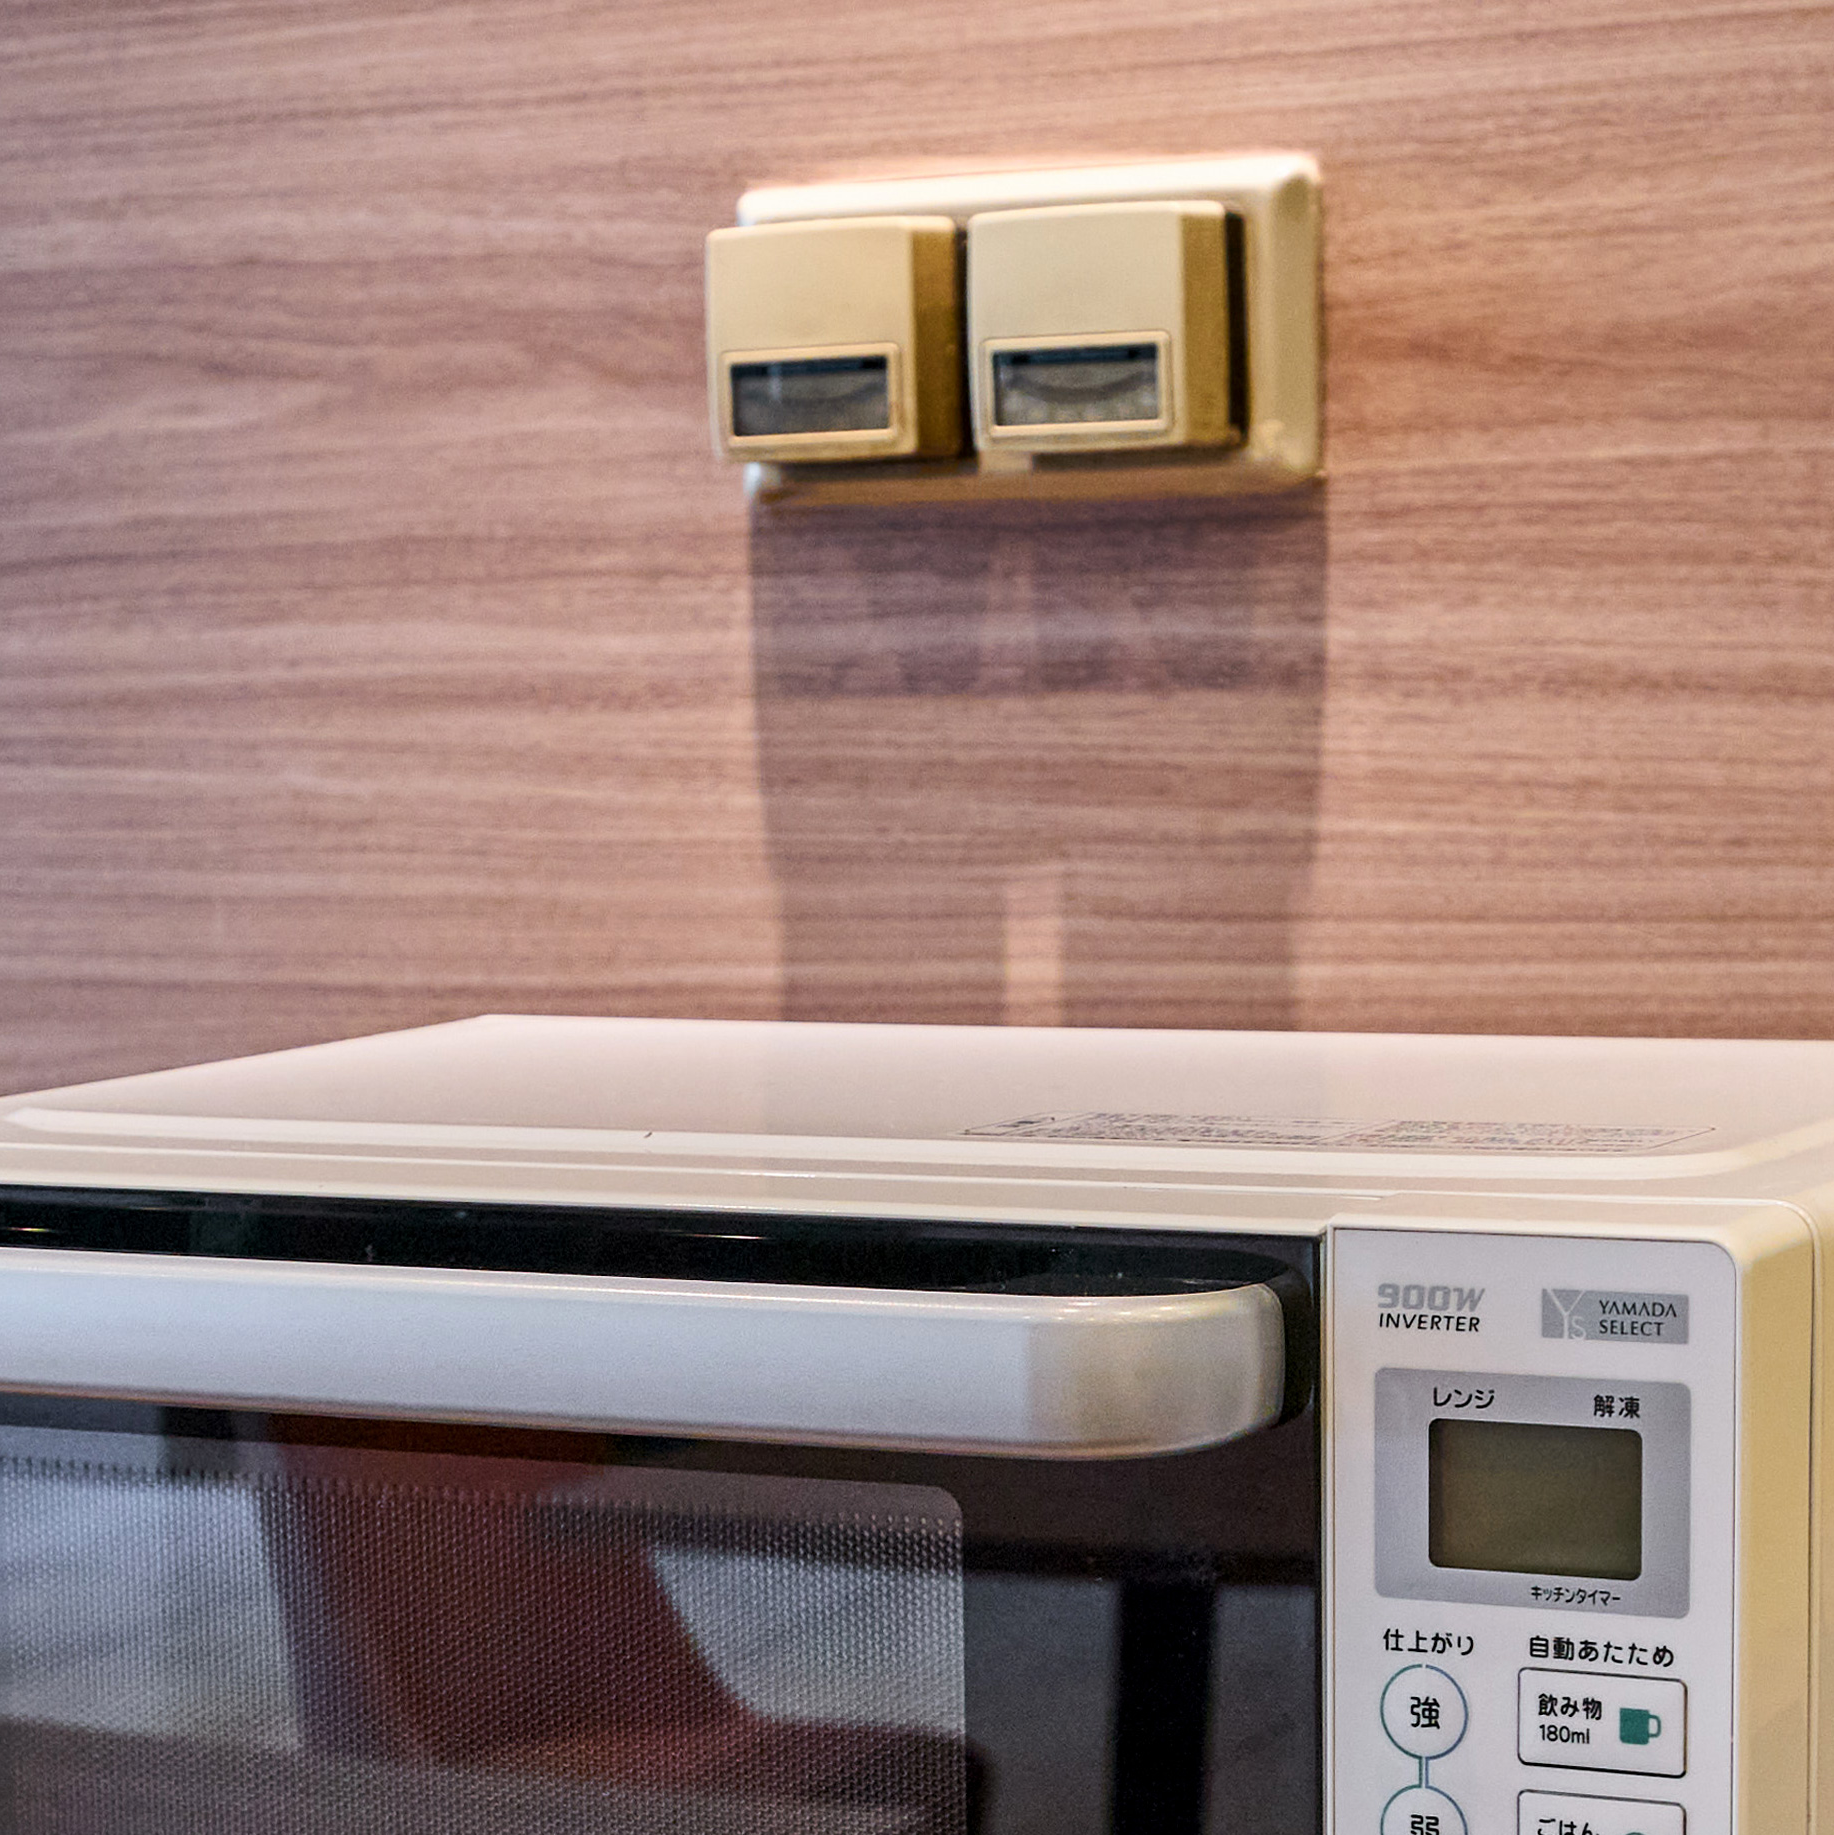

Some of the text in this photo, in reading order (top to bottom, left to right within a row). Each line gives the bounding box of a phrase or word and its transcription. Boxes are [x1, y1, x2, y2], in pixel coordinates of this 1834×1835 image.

[1378, 1283, 1485, 1312] 900W
[1599, 1300, 1677, 1317] YAMADA
[1380, 1313, 1479, 1332] INVERTER
[1600, 1320, 1664, 1336] SELECT
[1434, 1387, 1494, 1409] レンジ
[1594, 1395, 1640, 1418] 解凍
[1531, 1586, 1620, 1606] キッチンタイマー
[1383, 1629, 1473, 1655] 仕上がり
[1528, 1635, 1674, 1668] 自動あたため
[1411, 1697, 1440, 1729] 強
[1538, 1693, 1602, 1720] 飲み物
